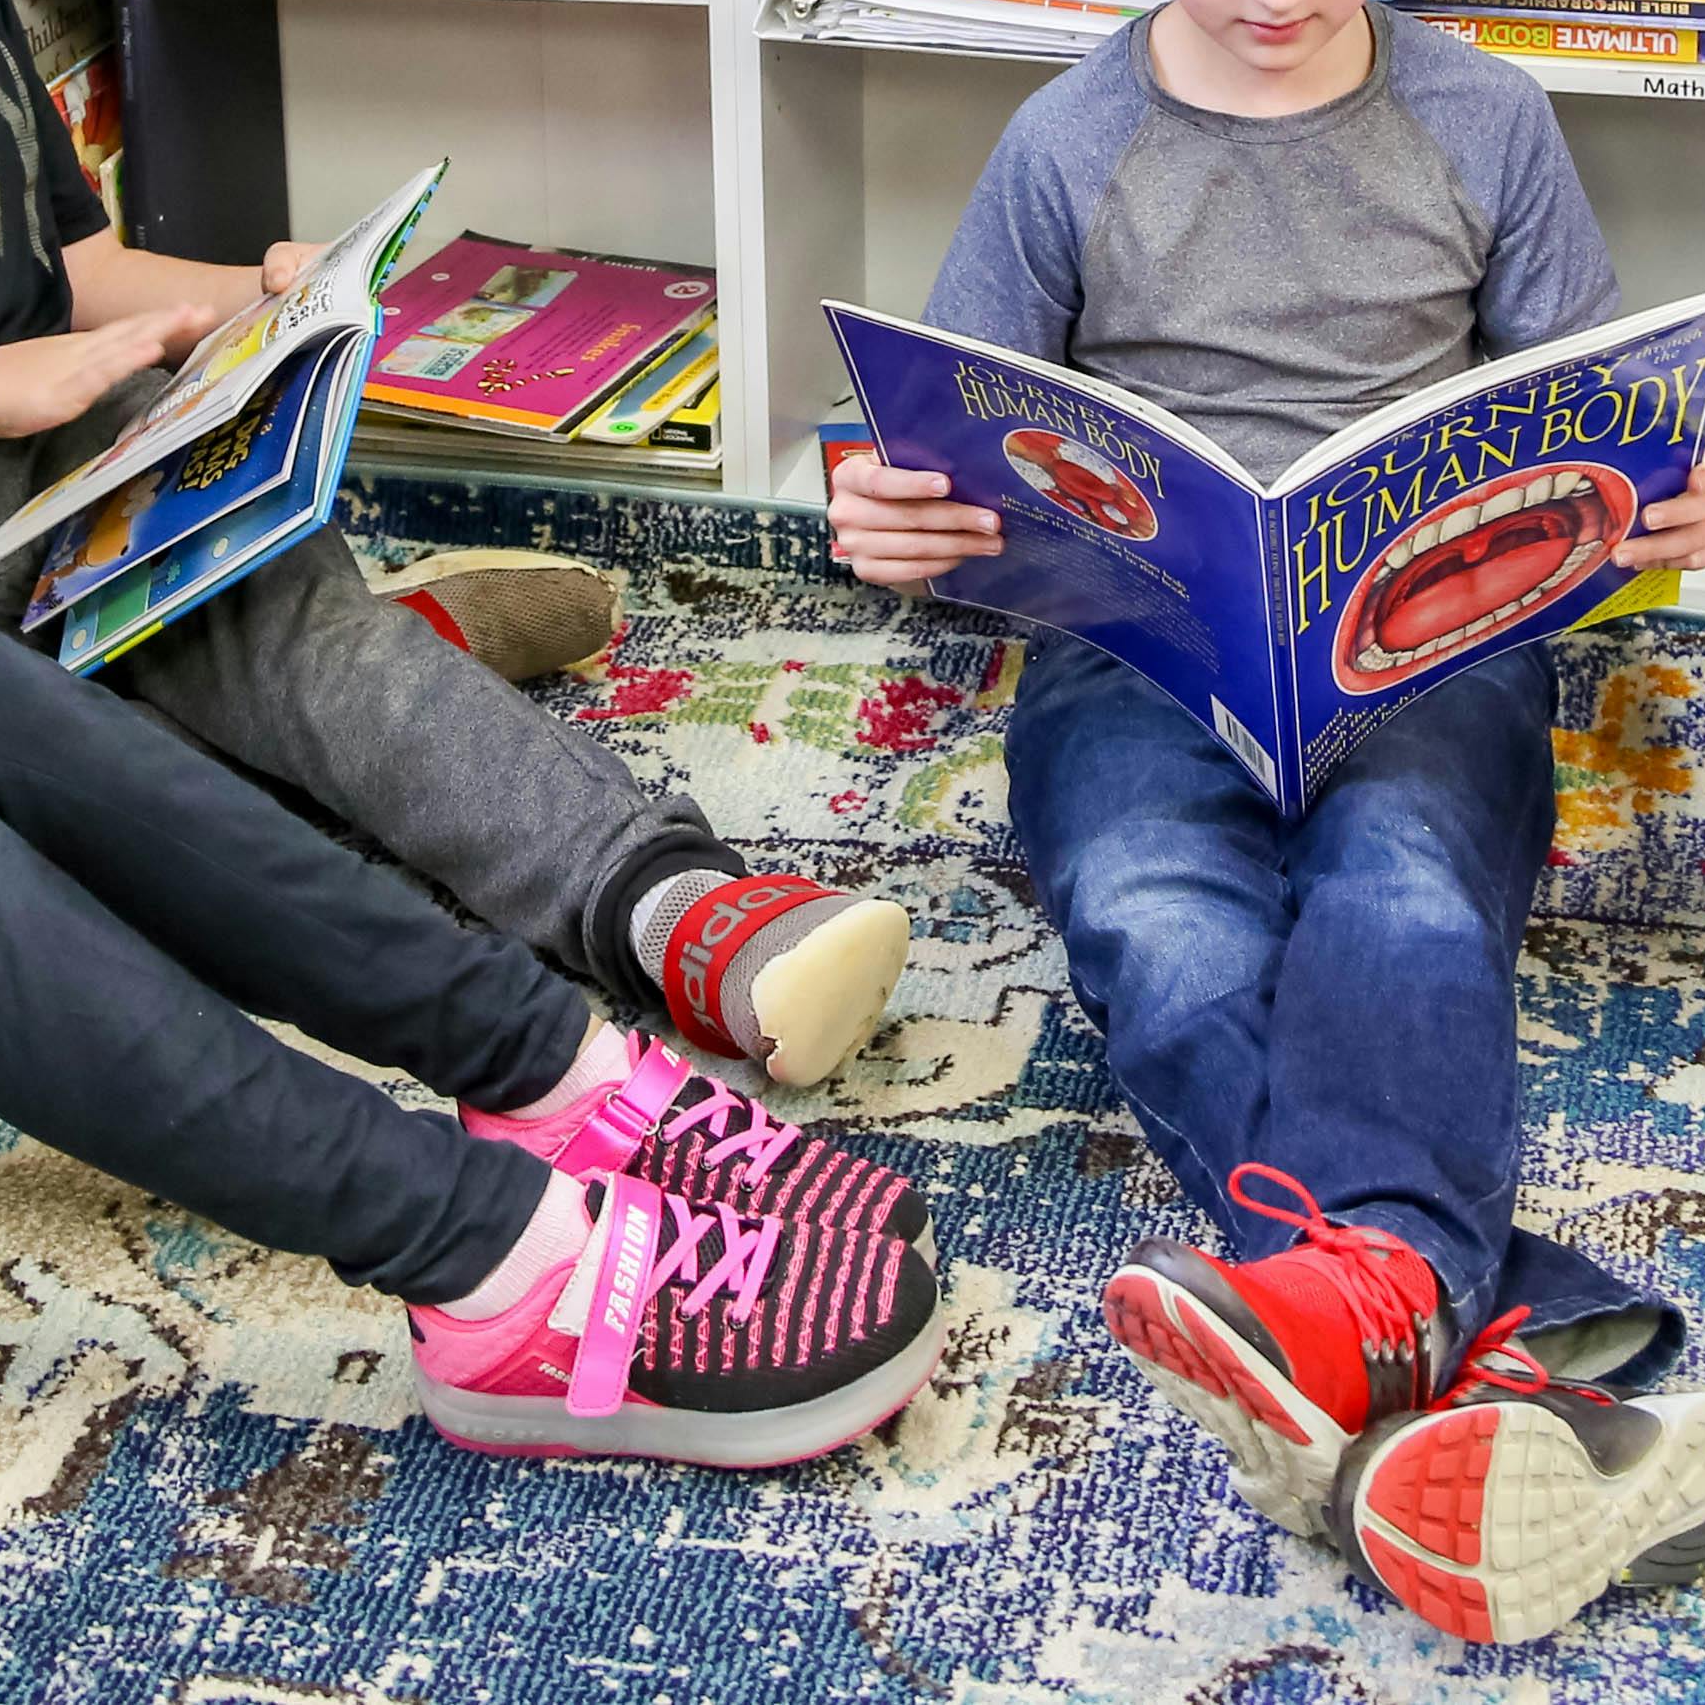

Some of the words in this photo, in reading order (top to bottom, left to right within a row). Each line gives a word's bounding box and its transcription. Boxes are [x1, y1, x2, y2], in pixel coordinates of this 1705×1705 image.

[1555, 25, 1679, 56] ULTIMATE
[1644, 77, 1704, 97] Math
[954, 373, 1079, 437] HUMAN
[1084, 422, 1165, 499] BODY
[957, 359, 1117, 432] JOURNEY
[1301, 354, 1630, 537] JOURNEY
[1293, 425, 1524, 633] HUMAN
[603, 1203, 651, 1336] FASHION
